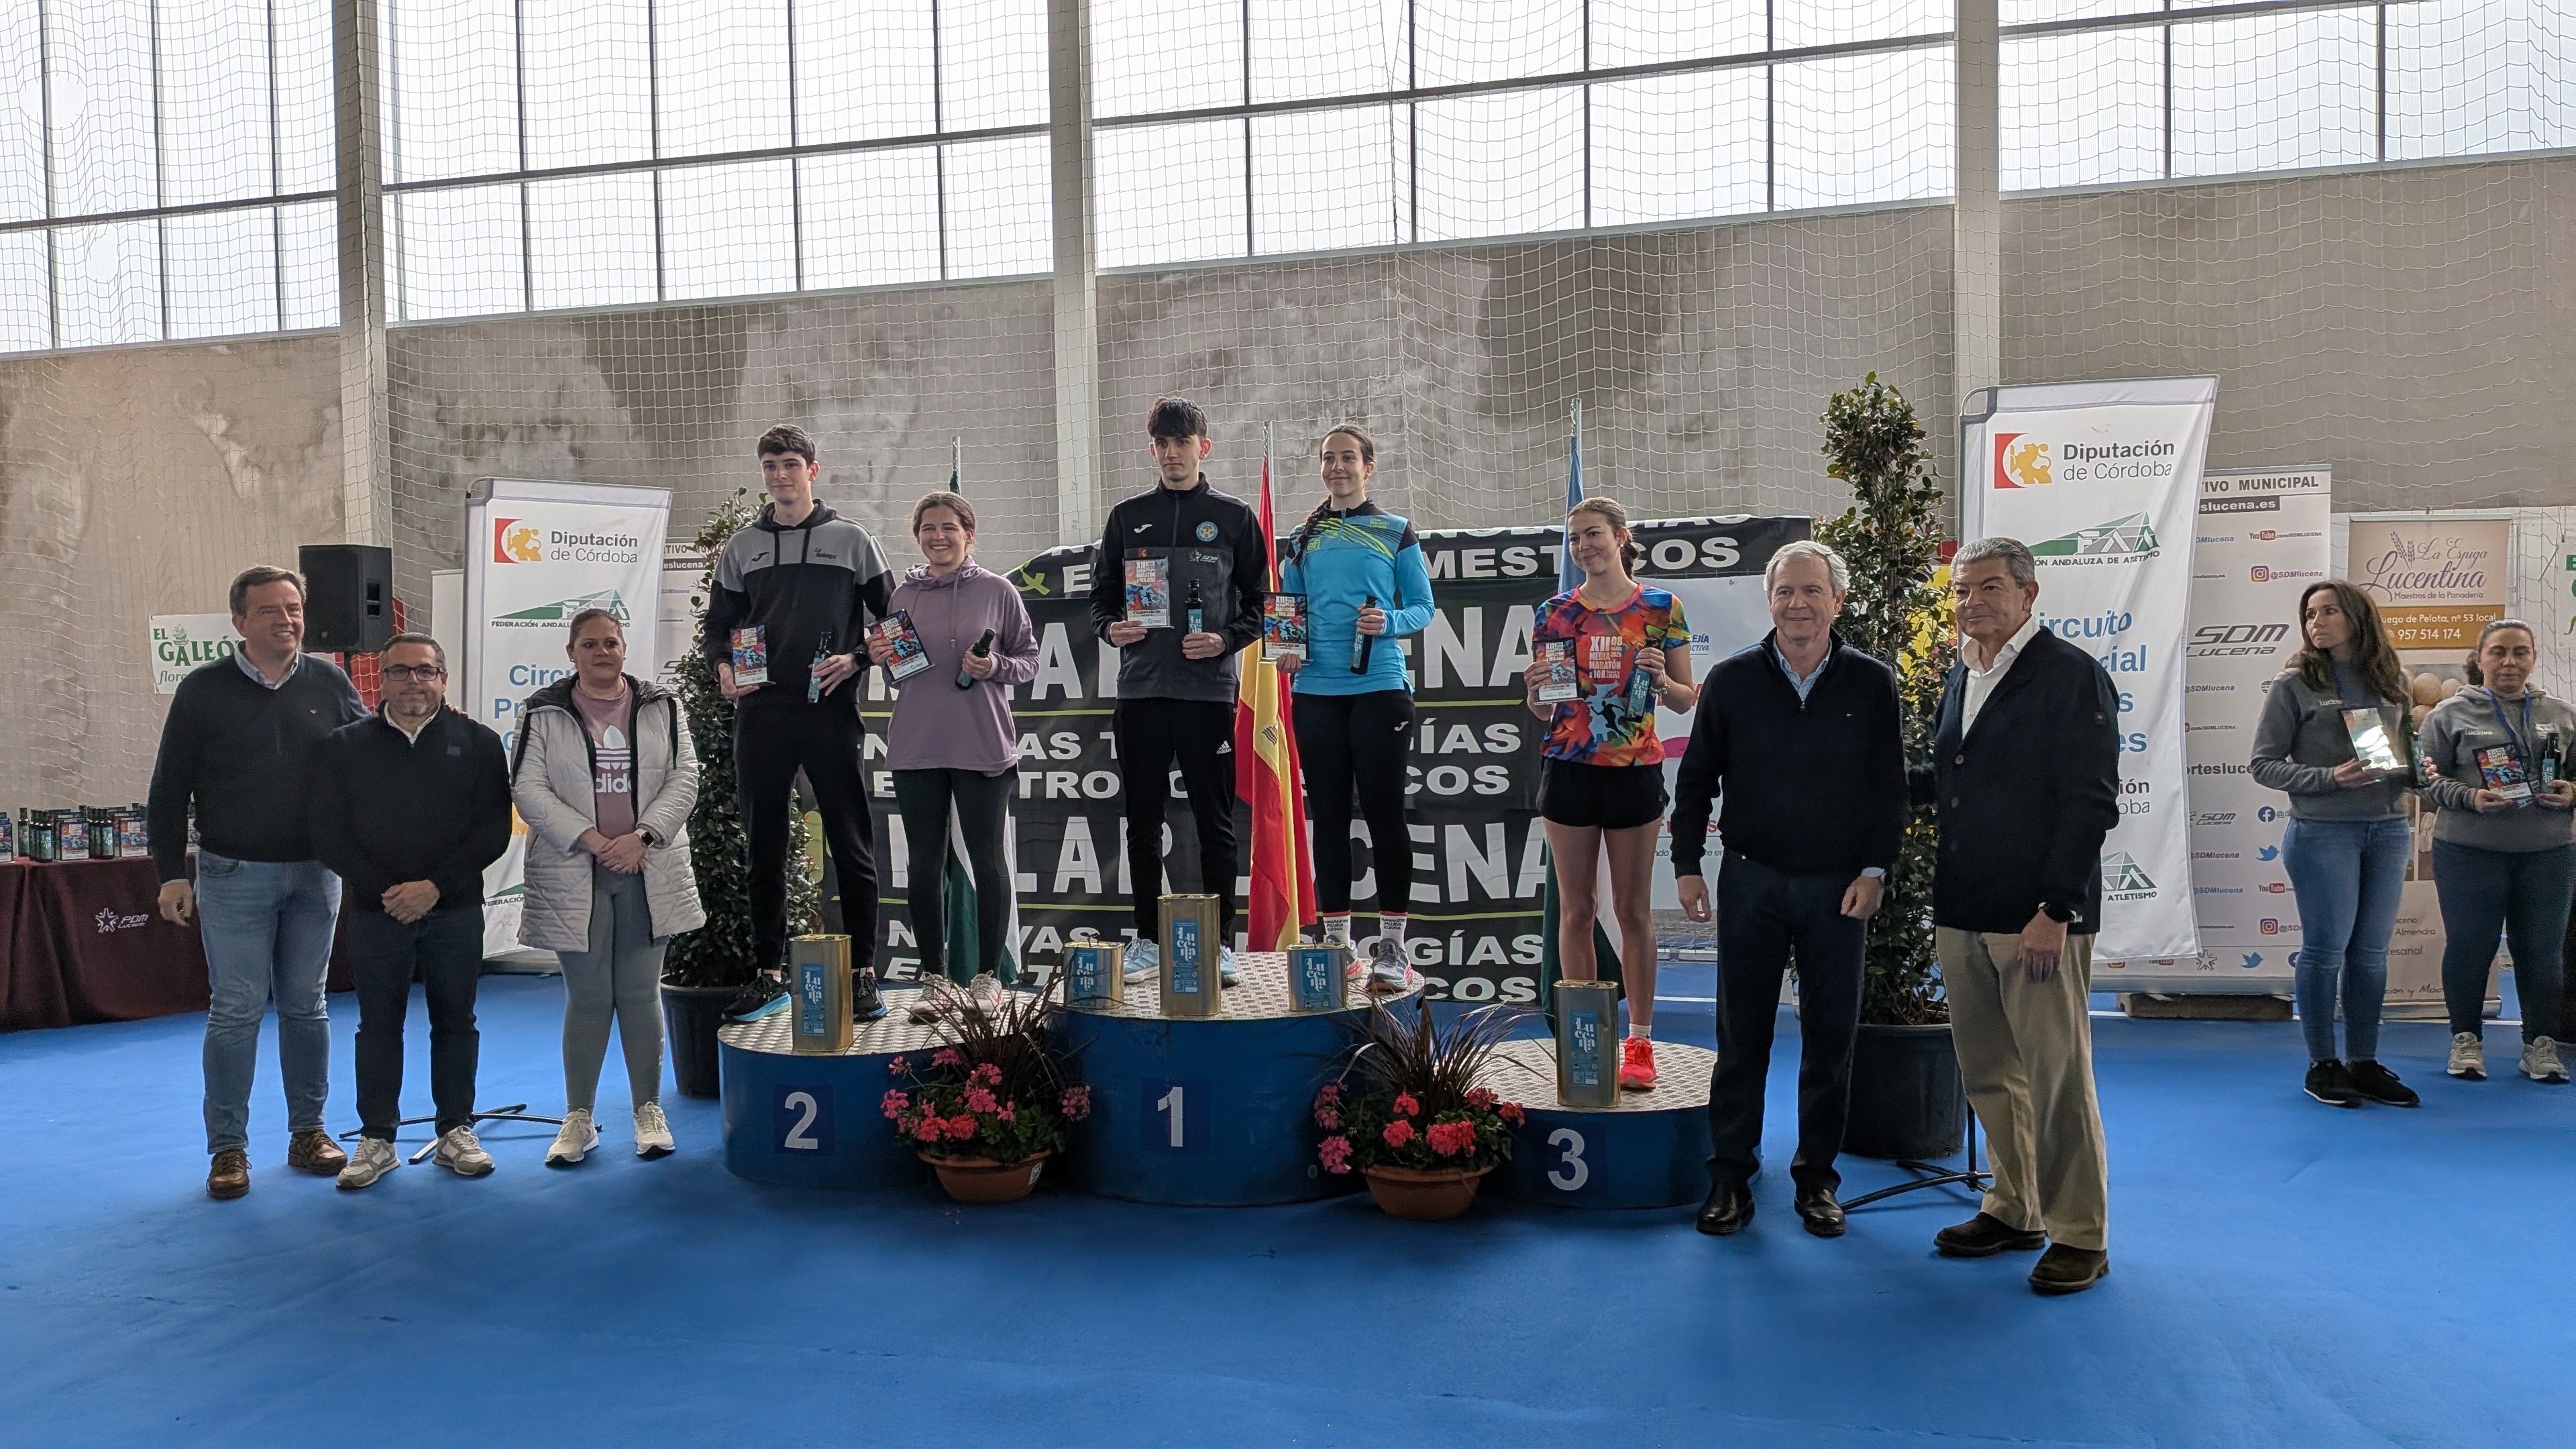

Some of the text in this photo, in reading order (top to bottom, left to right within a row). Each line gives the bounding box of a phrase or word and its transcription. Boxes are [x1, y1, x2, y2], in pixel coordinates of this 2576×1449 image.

[2063, 439, 2174, 462] Diputación
[2063, 461, 2172, 480] de Córdoba
[2239, 476, 2319, 491] MUNICIPAL
[551, 531, 638, 548] Diputación
[551, 547, 637, 563] de Córdoba
[2416, 537, 2489, 570] La Espiga
[2051, 557, 2103, 566] ANDALUZA
[2361, 550, 2487, 602] Lucentina
[2394, 592, 2426, 600] Maestros
[491, 620, 538, 628] FEDERACIÓN
[2039, 610, 2133, 638] ircuito
[2381, 616, 2404, 625] uego
[2406, 614, 2417, 623] de
[2463, 614, 2473, 622] 53
[153, 629, 168, 639] EL
[2188, 623, 2290, 645] SDM
[2398, 629, 2462, 640] 957 514 174
[158, 635, 236, 666] GALEÓ
[1590, 636, 1610, 651] XII
[1589, 651, 1610, 660] MEDIA
[1589, 660, 1621, 669] MARATÓN
[2201, 812, 2237, 820] SDM
[2107, 891, 2157, 902] ATLETISMO
[2395, 927, 2436, 936] Almendra
[784, 1091, 818, 1150] 2
[1157, 1087, 1183, 1148] 1
[1547, 1128, 1589, 1191] 3
